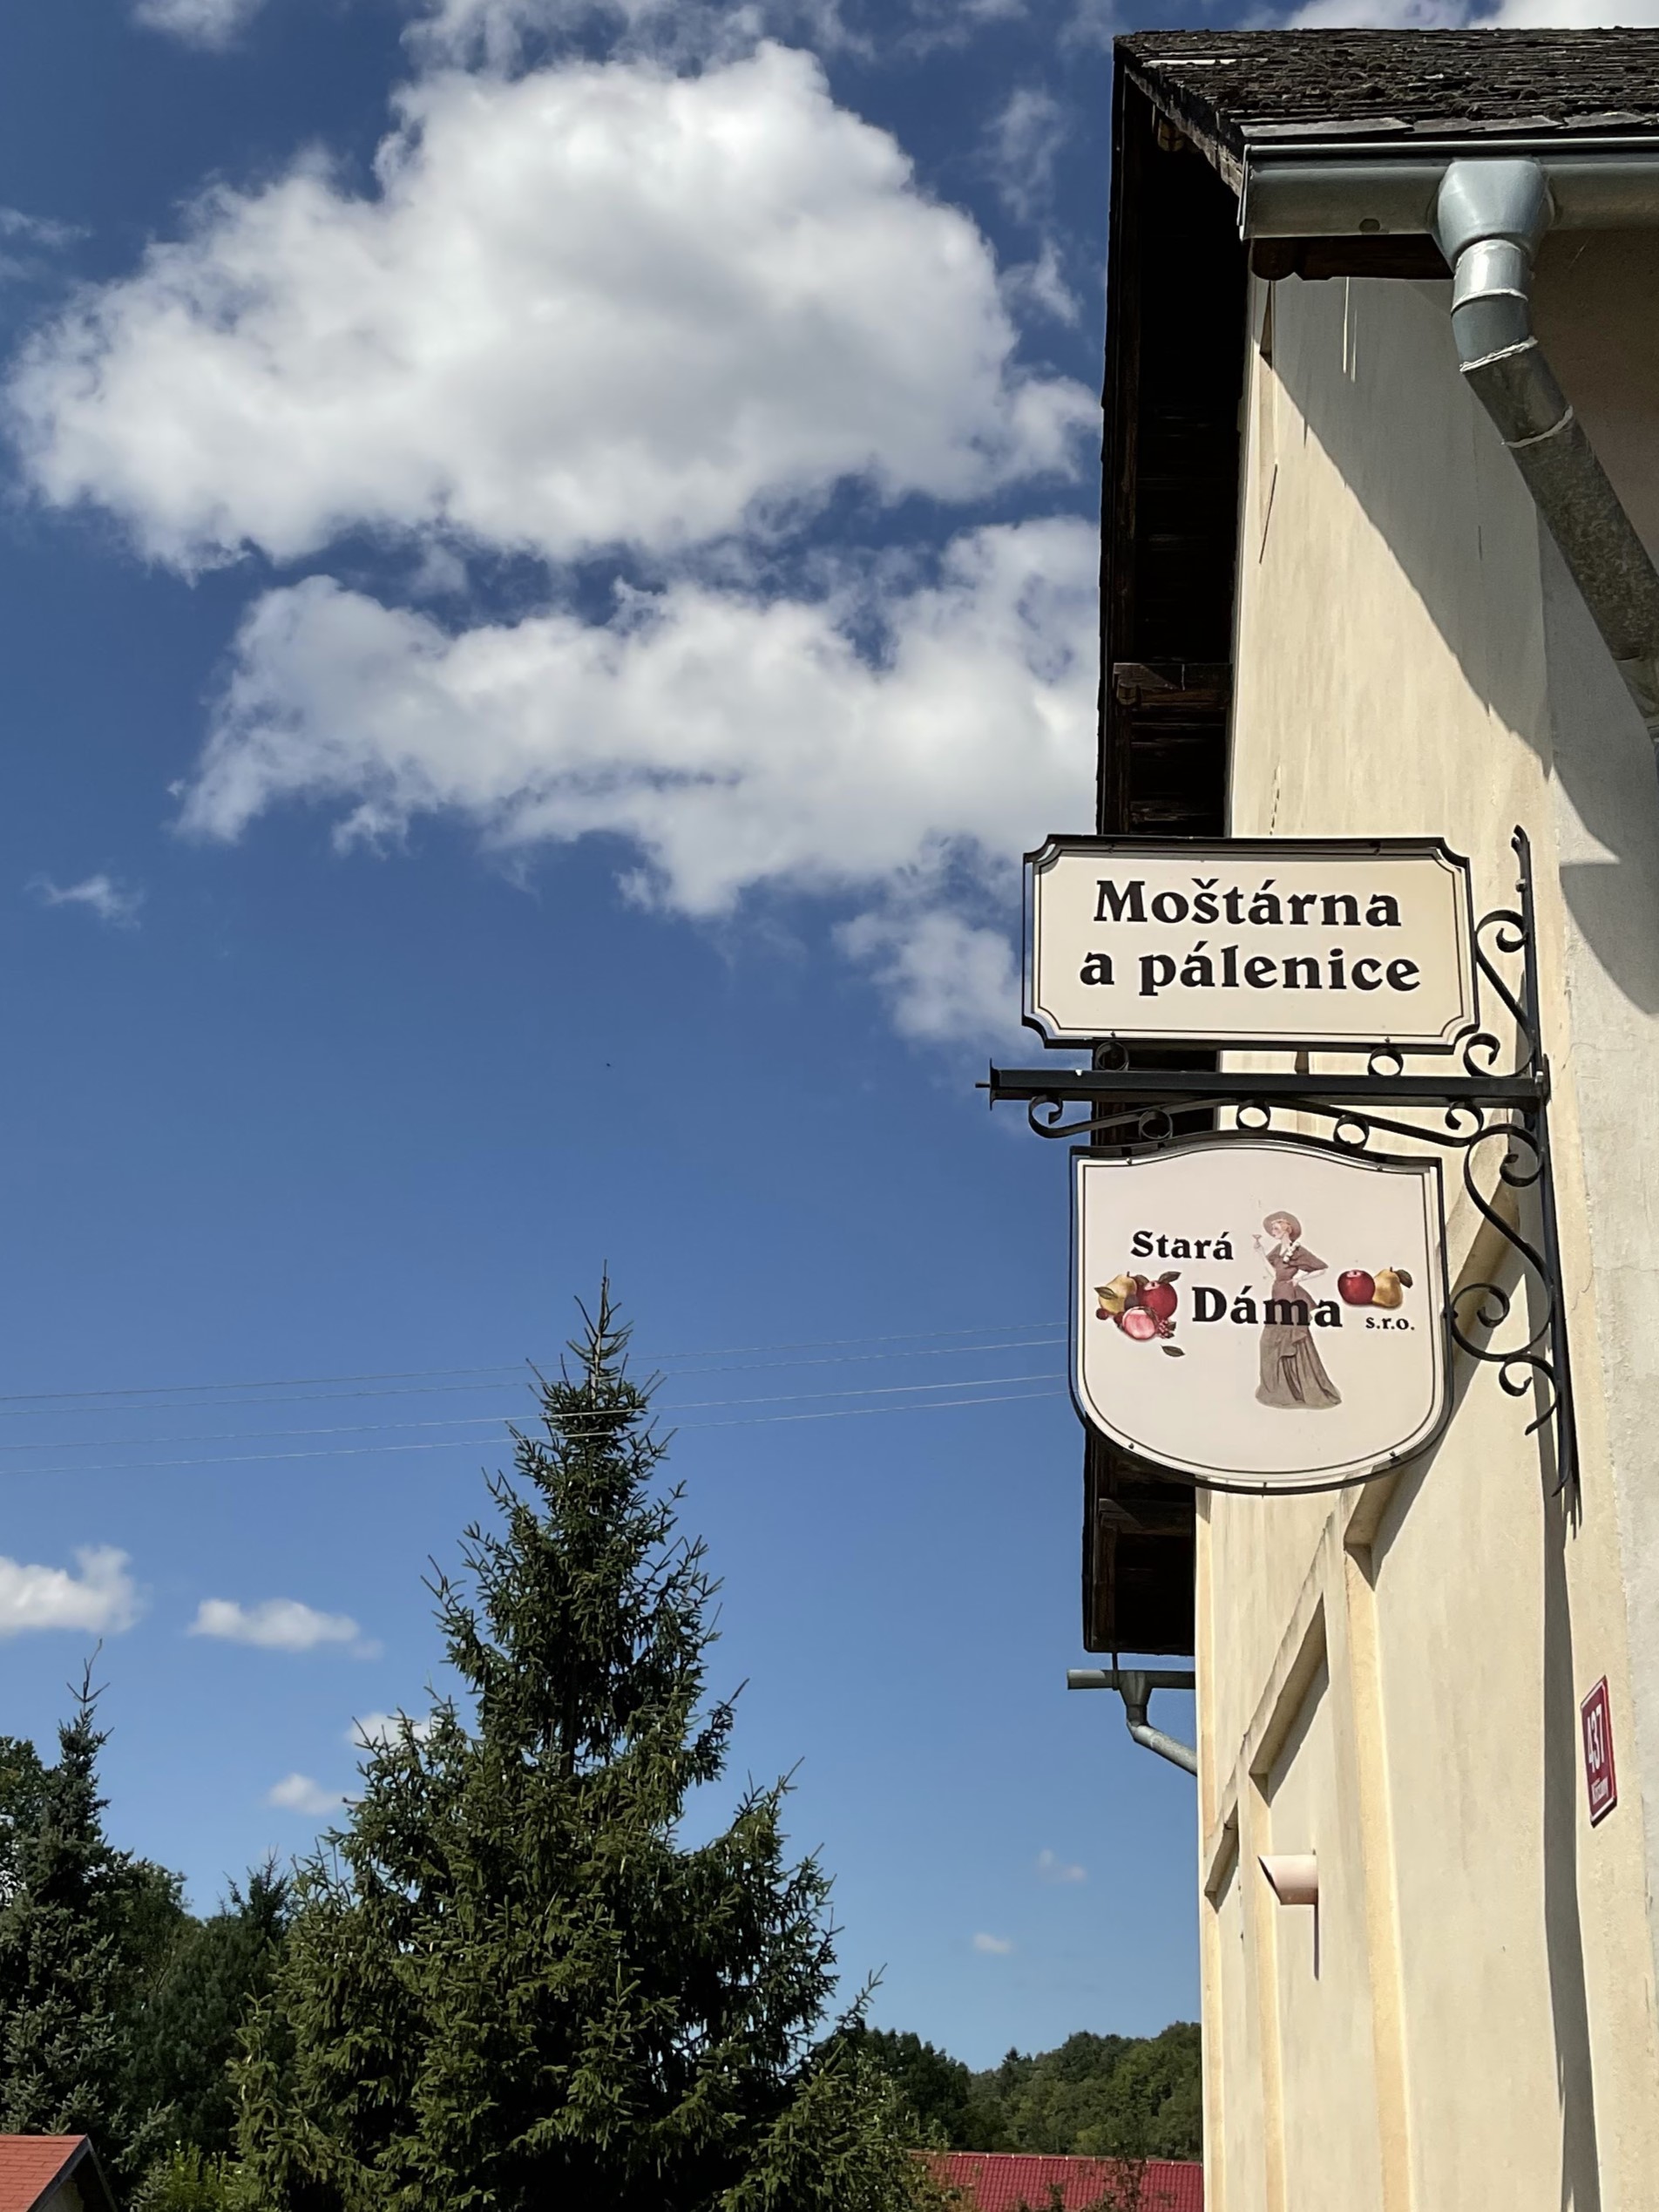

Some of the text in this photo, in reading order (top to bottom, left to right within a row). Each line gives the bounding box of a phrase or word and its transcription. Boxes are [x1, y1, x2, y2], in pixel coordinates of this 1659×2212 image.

[1093, 878, 1402, 927] Moštárna
[1080, 940, 1421, 997] a pálenice
[1130, 1231, 1234, 1260] Stará
[1191, 1285, 1416, 1331] Dáma s.r.o.
[1587, 1703, 1605, 1774] 437
